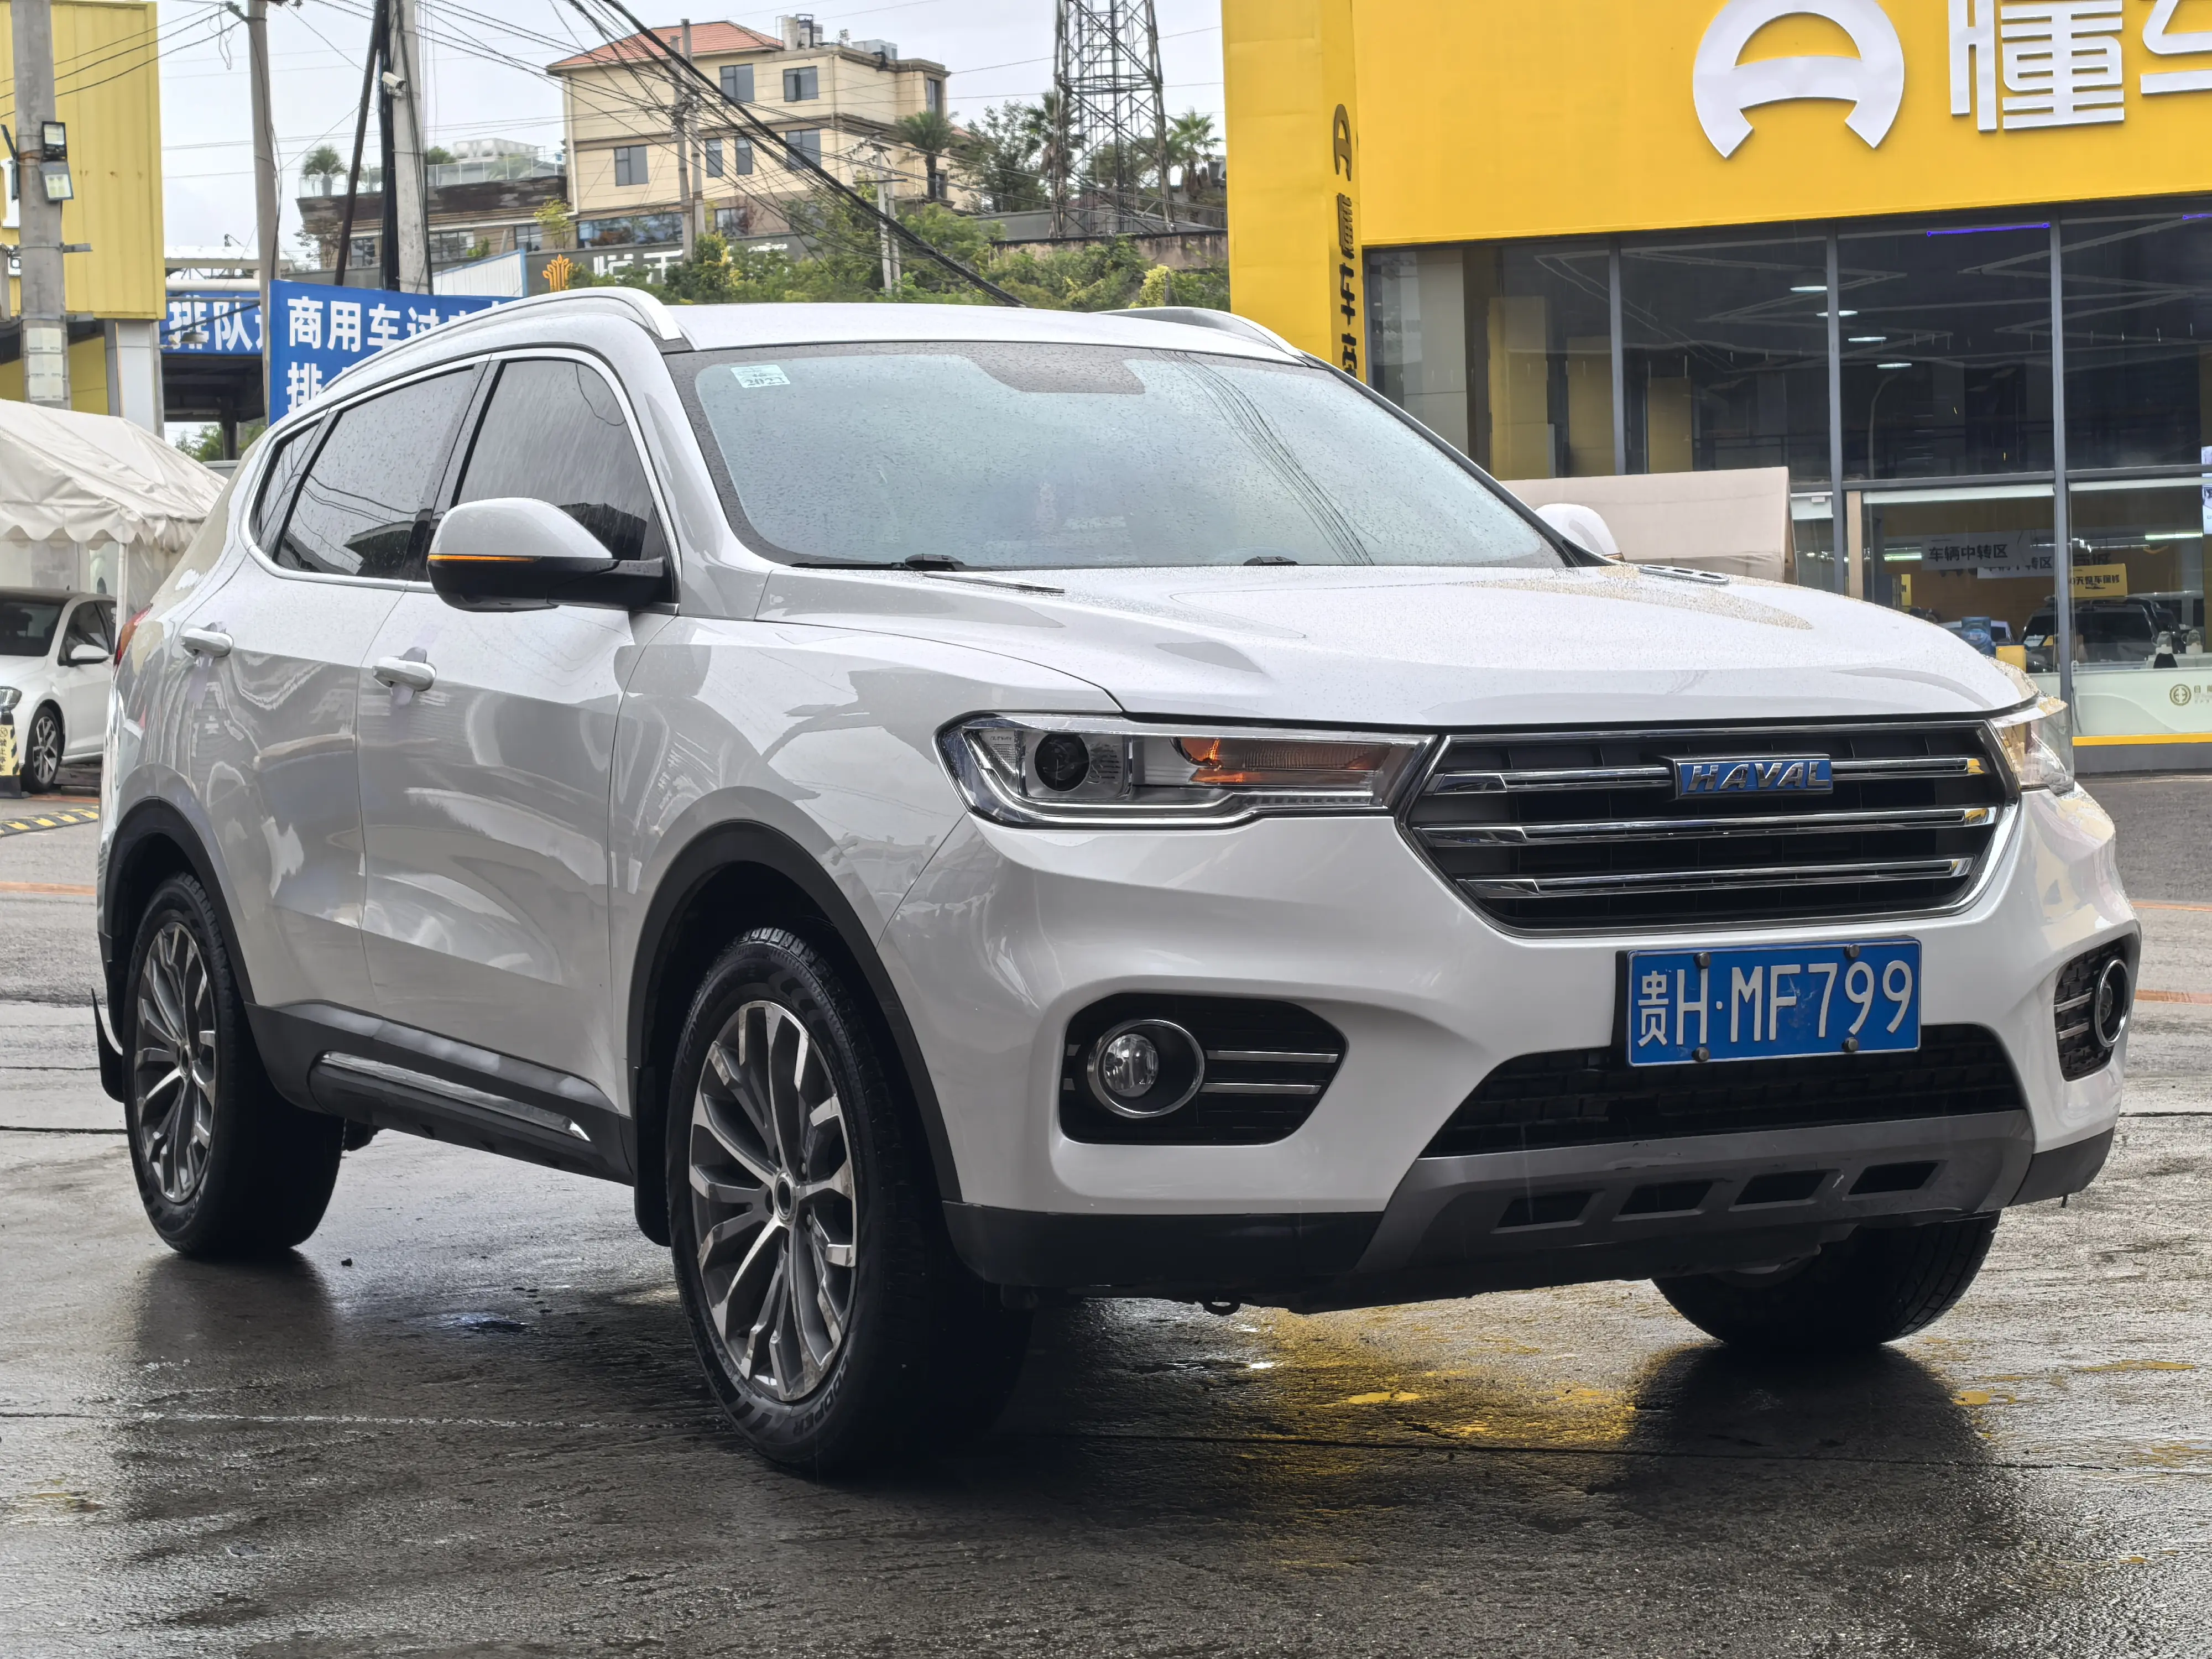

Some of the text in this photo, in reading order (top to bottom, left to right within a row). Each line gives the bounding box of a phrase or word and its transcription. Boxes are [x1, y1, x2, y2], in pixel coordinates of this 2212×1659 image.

[168, 295, 262, 351] 排队
[1928, 544, 2008, 562] 车辆中转区
[1687, 762, 1830, 791] HAVAL
[1637, 960, 1913, 1047] 贵H·MF799
